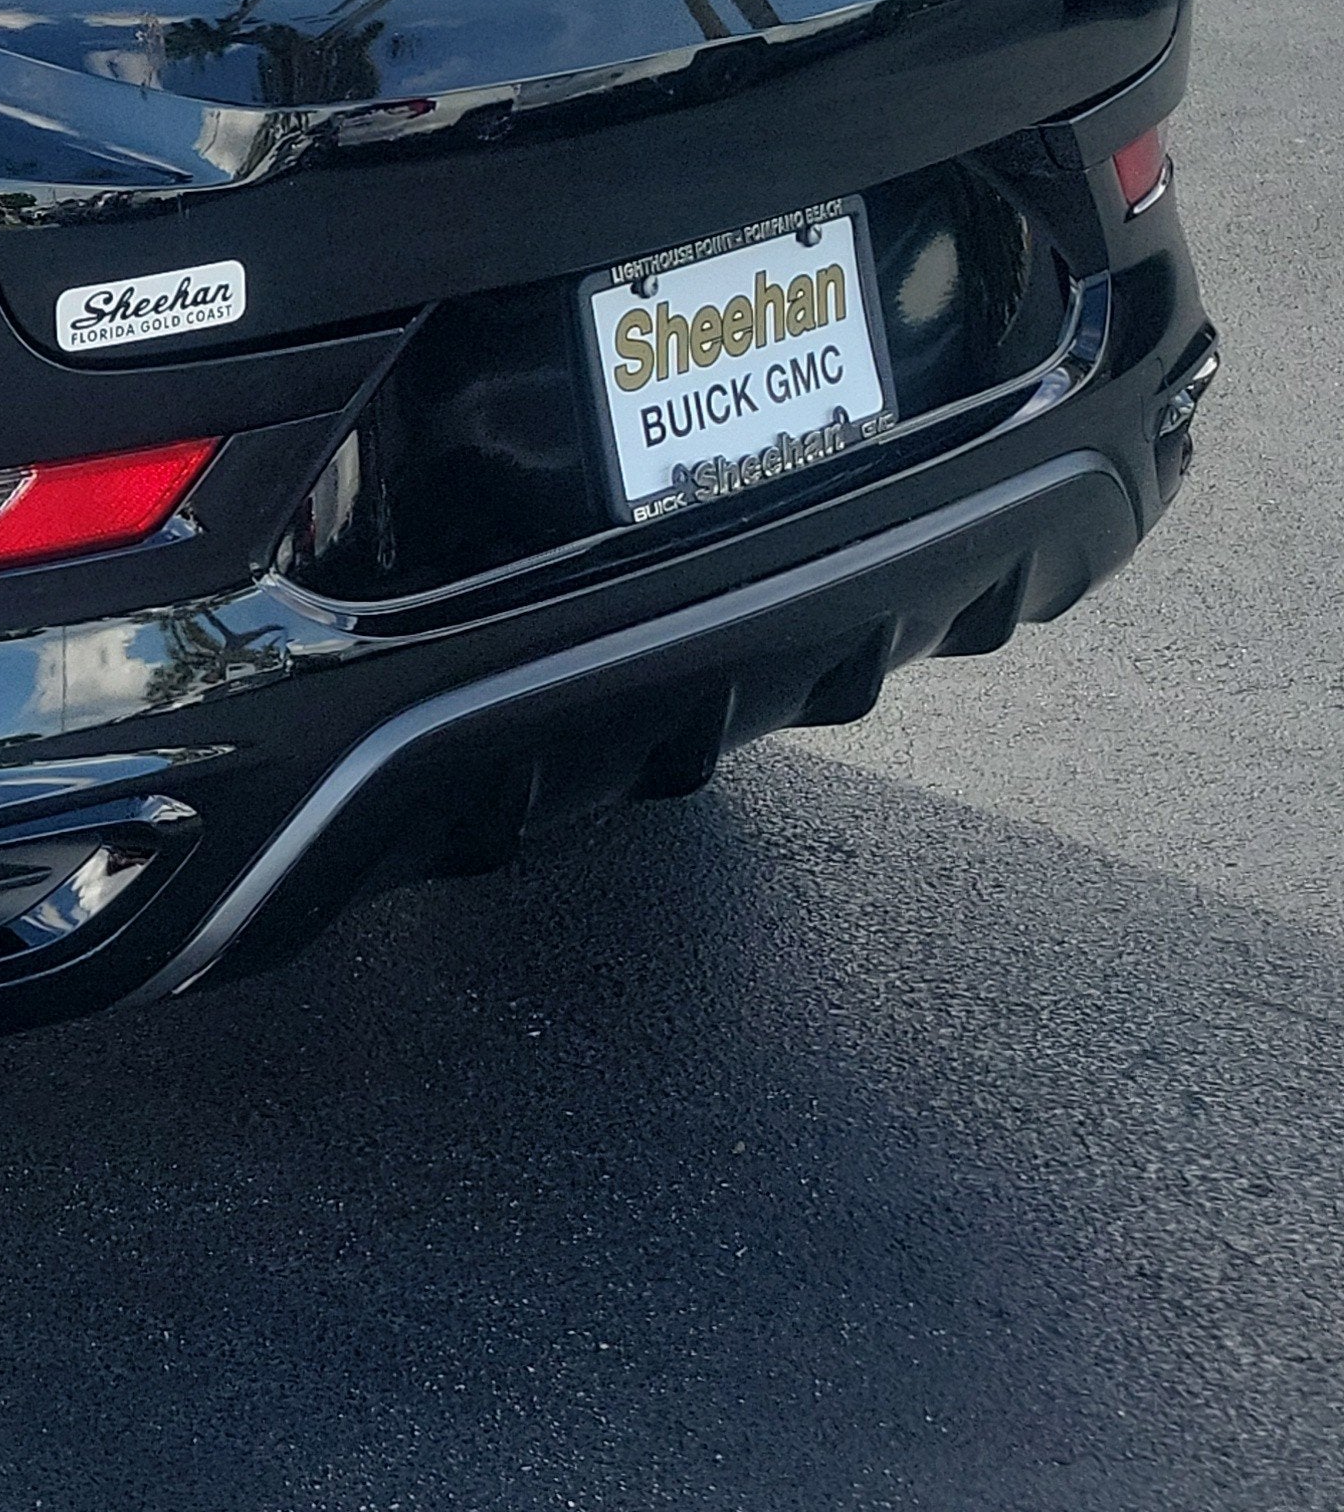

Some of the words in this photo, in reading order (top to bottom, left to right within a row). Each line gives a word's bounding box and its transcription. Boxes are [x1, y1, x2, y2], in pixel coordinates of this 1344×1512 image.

[611, 244, 694, 284] LIGHTHOUSE
[694, 232, 732, 259] POINT
[743, 210, 804, 243] POMPANO
[805, 198, 842, 224] BEACH
[70, 276, 232, 330] Sheehan
[71, 323, 135, 345] FLORIDA
[141, 315, 181, 333] GOLD
[186, 305, 232, 323] COAST
[614, 263, 846, 392] Sheehan
[640, 373, 759, 448] BUICK
[766, 345, 844, 403] GMC
[633, 492, 689, 522] BUICK
[694, 424, 846, 500] Sheehan
